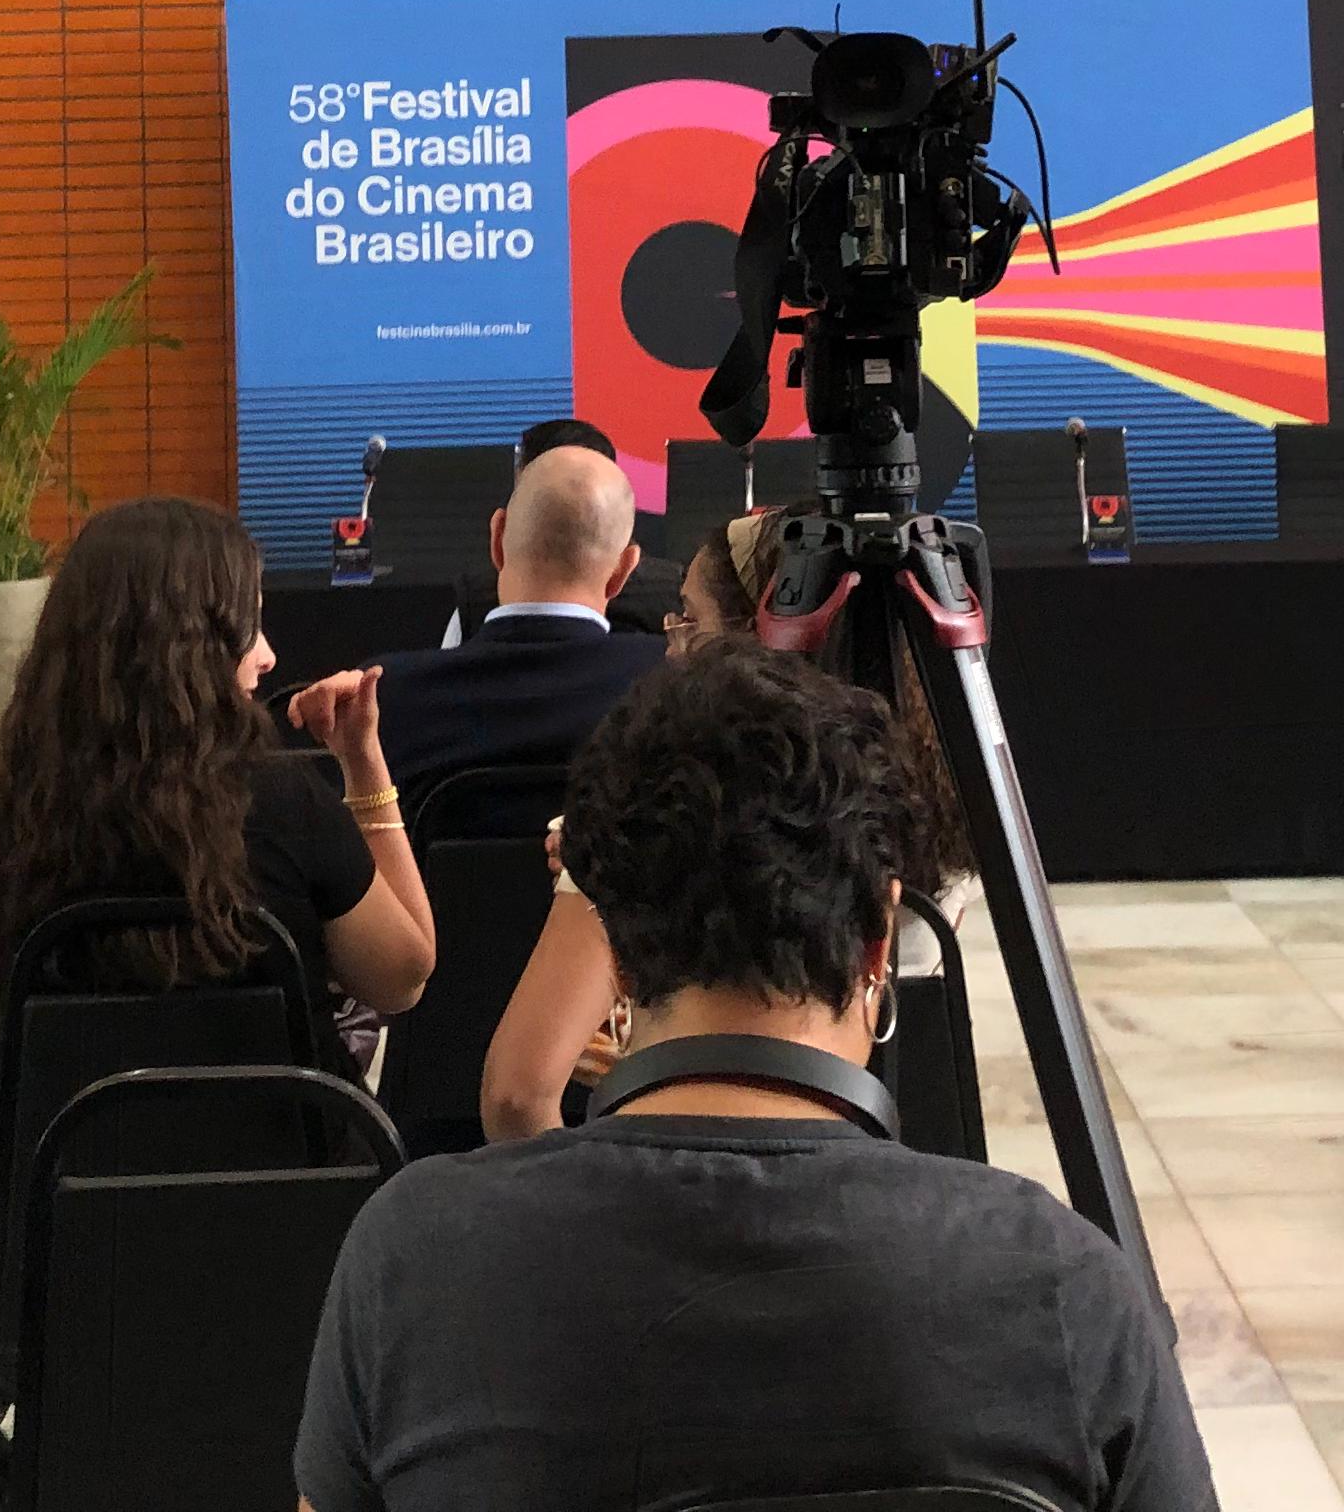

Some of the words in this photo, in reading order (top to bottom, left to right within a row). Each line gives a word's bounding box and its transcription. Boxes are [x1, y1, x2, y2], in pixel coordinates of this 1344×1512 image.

[363, 77, 531, 121] Festival
[302, 129, 358, 170] de
[371, 124, 532, 168] Brasília
[286, 178, 345, 218] do
[358, 175, 533, 216] Cinema
[316, 219, 535, 265] Brasileiro
